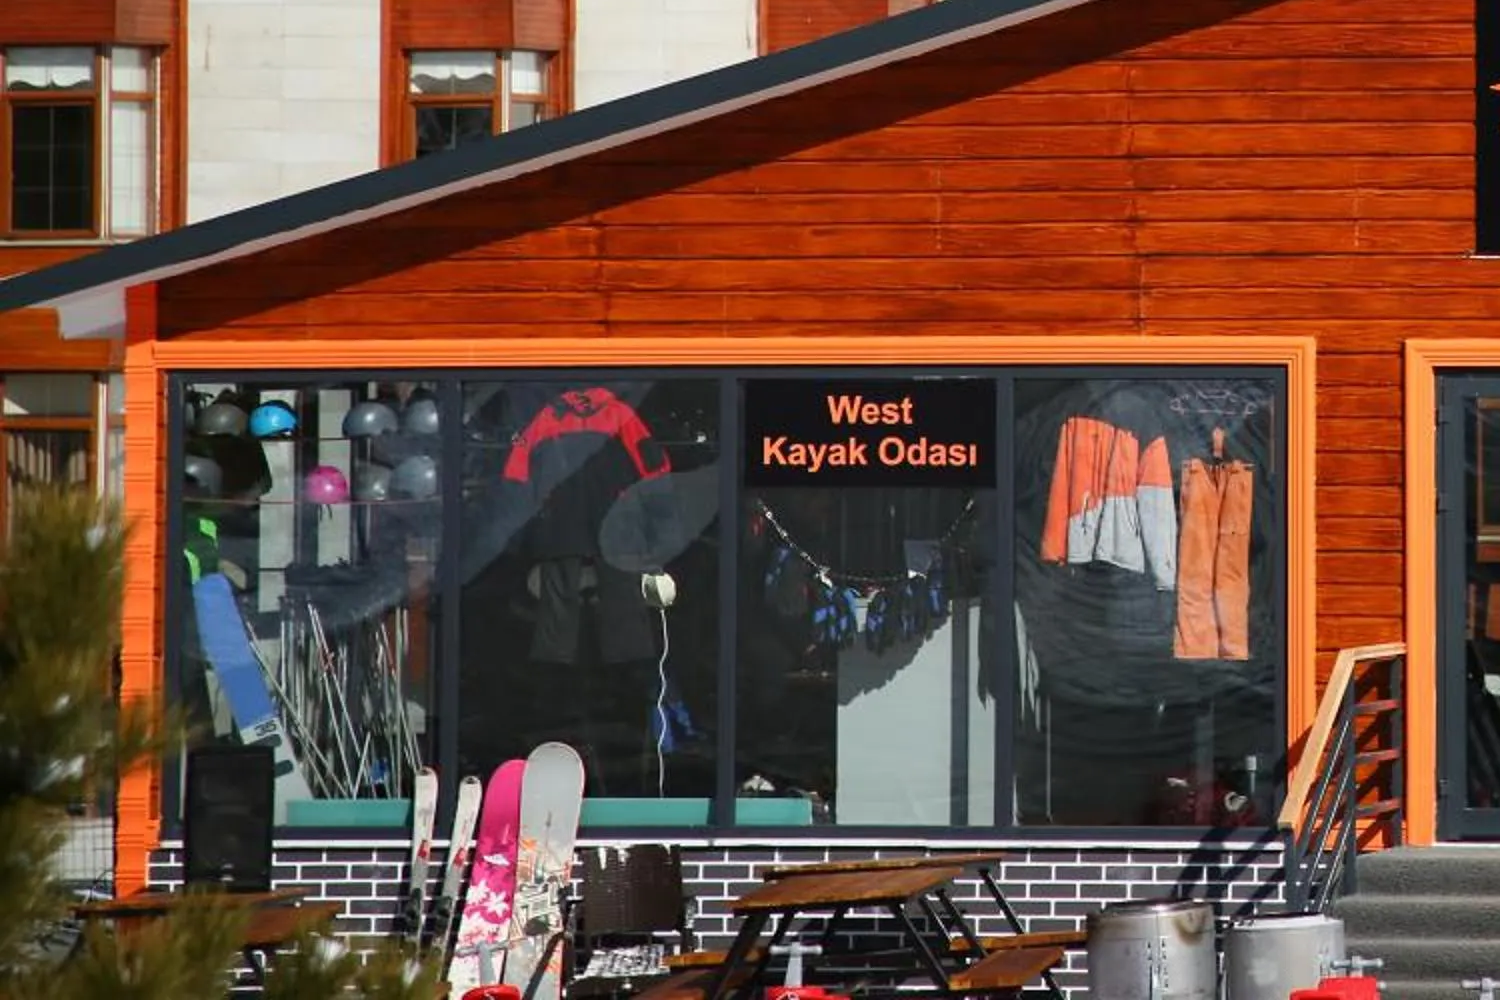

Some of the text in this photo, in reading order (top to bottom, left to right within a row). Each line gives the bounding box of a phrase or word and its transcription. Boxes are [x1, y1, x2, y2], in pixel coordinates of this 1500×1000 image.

[827, 395, 914, 425] West
[762, 436, 978, 474] Kayak Odası
